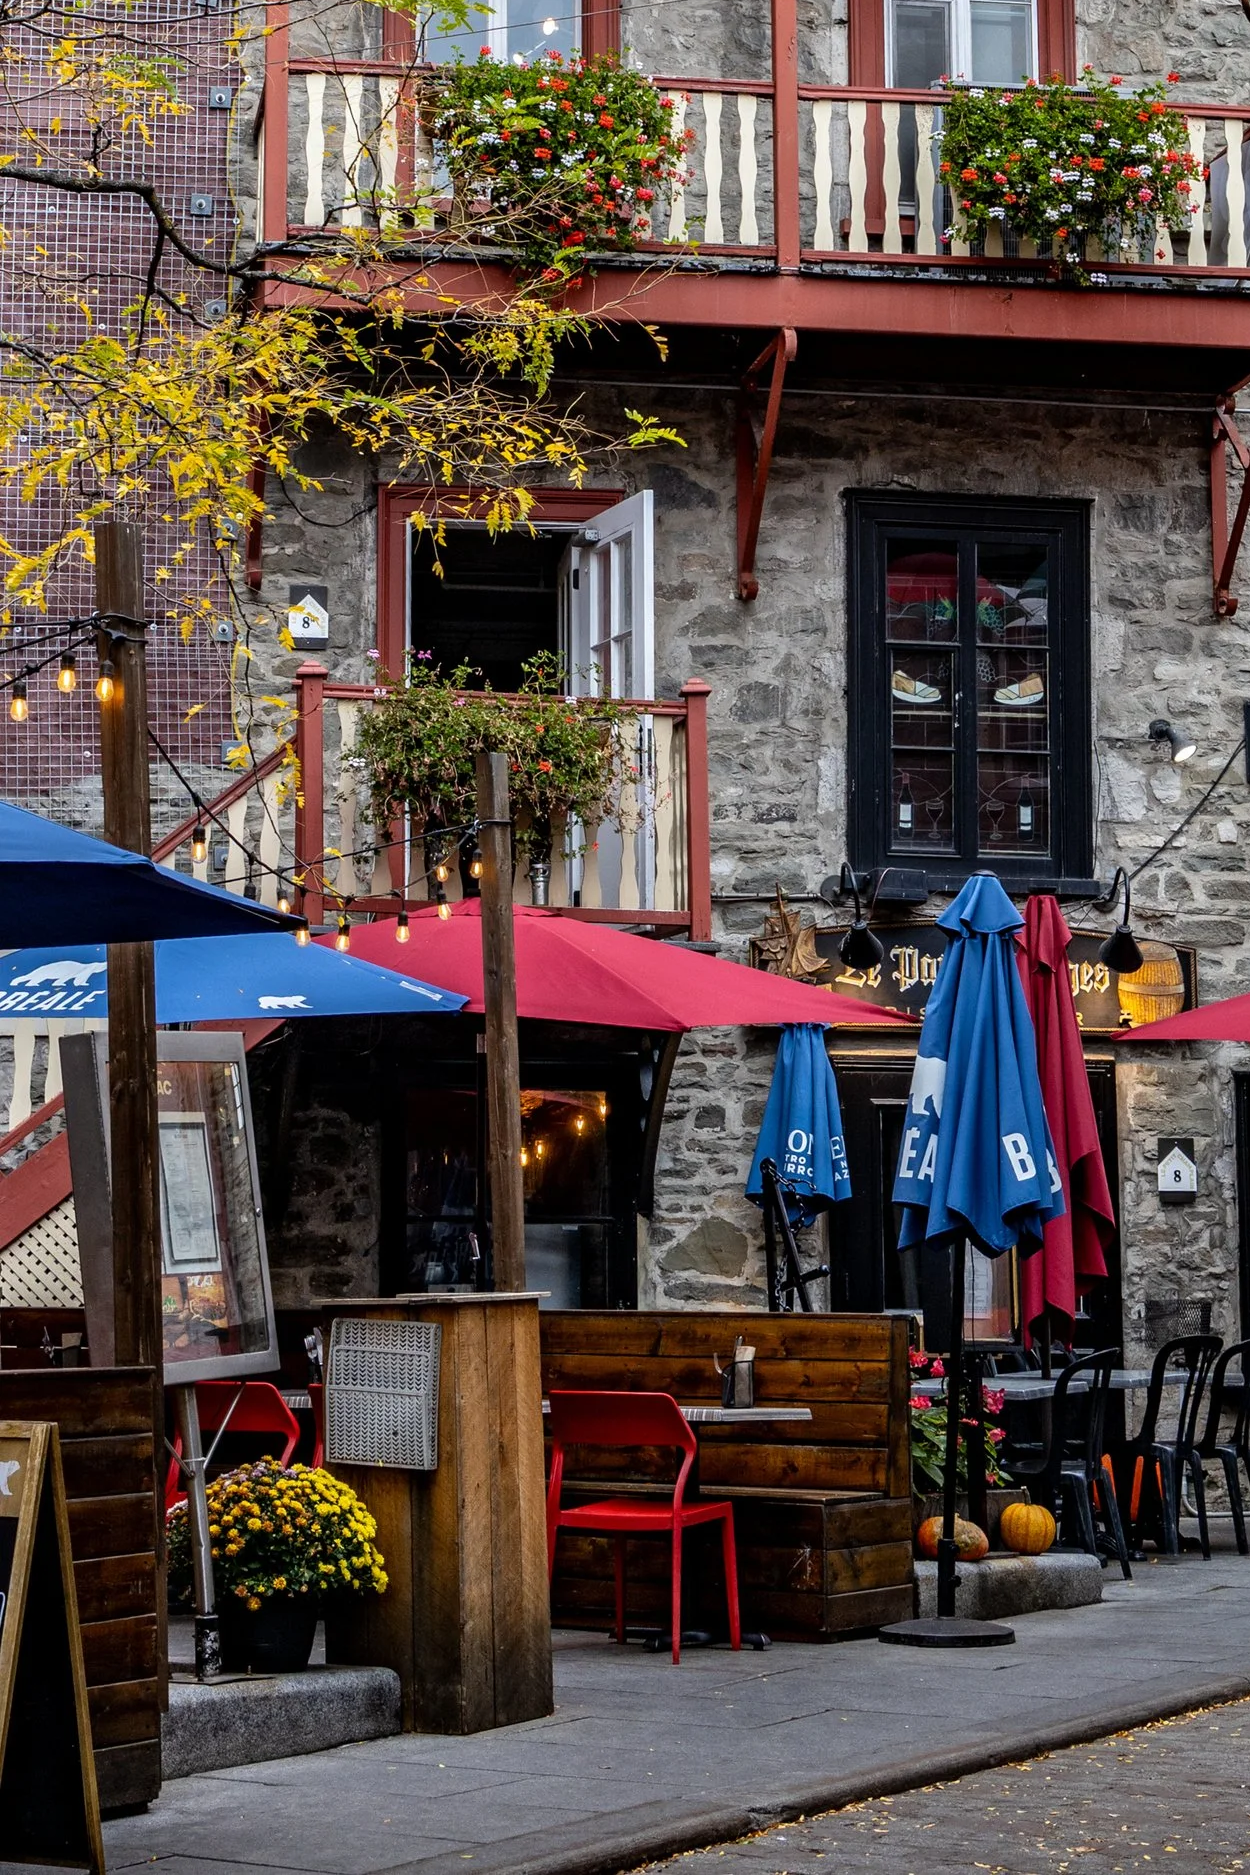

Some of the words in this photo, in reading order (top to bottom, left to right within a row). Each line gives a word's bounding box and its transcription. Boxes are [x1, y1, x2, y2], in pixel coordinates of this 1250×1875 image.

[890, 945, 944, 993] Pa
[1002, 1133, 1037, 1182] B
[1173, 1169, 1182, 1183] 8
